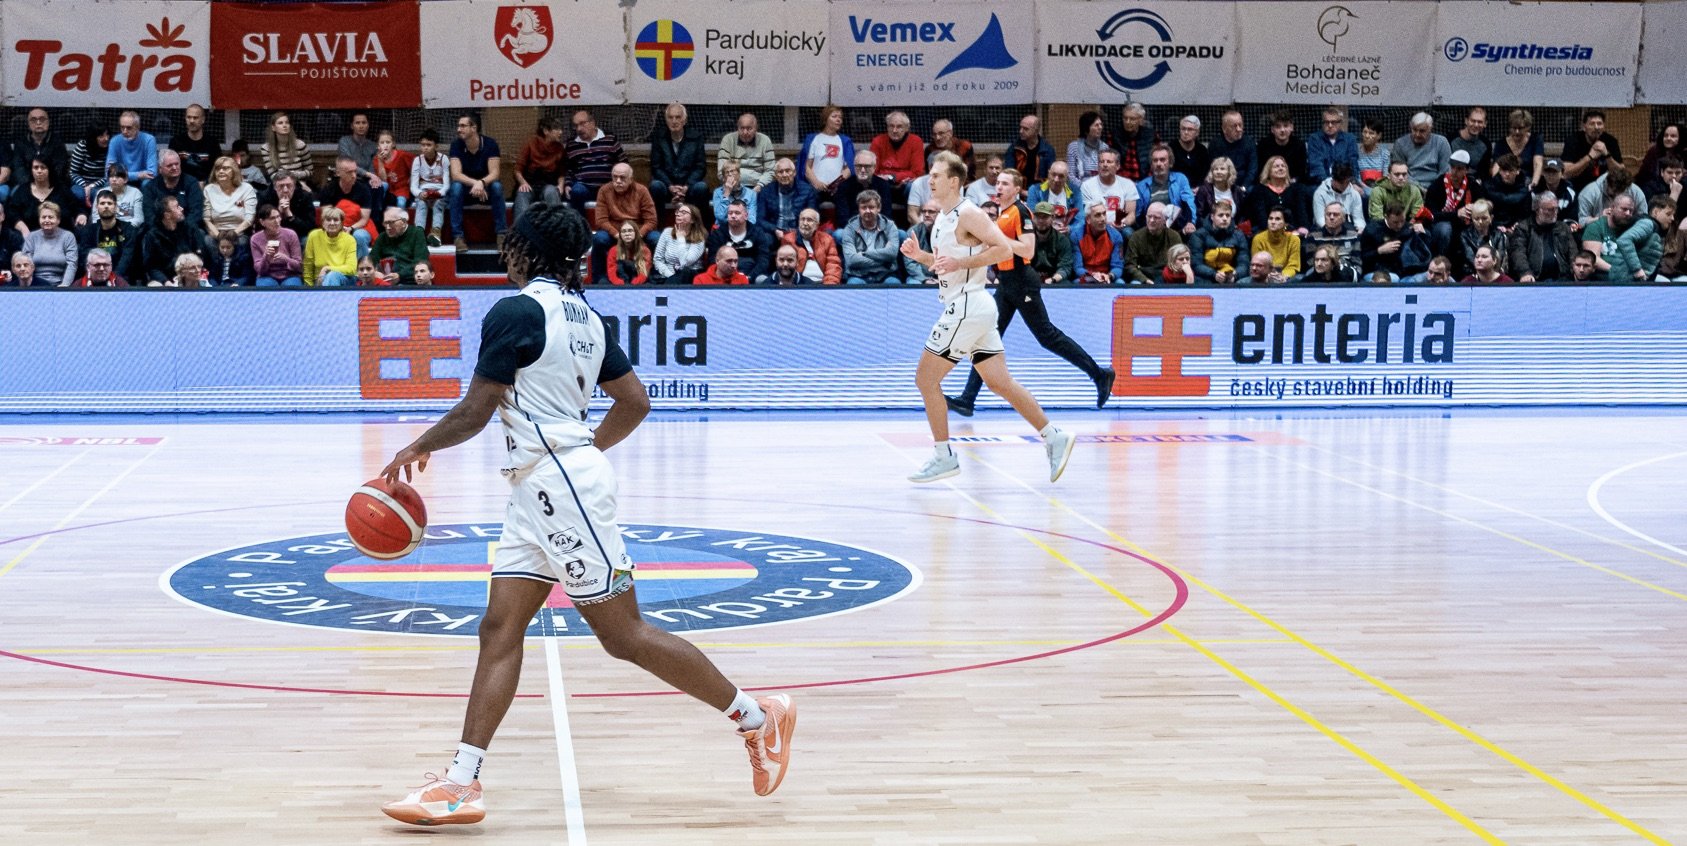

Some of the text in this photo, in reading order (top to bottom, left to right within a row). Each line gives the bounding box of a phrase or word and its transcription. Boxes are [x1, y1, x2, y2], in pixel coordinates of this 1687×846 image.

[848, 15, 956, 43] Vemex
[242, 32, 388, 64] SLAVIA
[705, 28, 826, 55] Pardubický
[1047, 43, 1224, 59] LIKVIDACE ODPADU
[856, 53, 924, 67] ENERGIE
[1471, 43, 1593, 63] Synthesia
[15, 39, 197, 92] Tatra
[300, 66, 389, 80] POJIŠŤOVNA
[705, 55, 745, 79] kraj
[1287, 64, 1381, 80] Bohdaneč
[1504, 63, 1625, 77] Chemie pro budoucnost
[469, 78, 581, 101] Pardubice
[857, 84, 863, 92] s
[933, 81, 948, 91] od
[956, 81, 985, 91] roku
[993, 80, 1019, 91] 2009
[1286, 81, 1379, 98] Medical Spa
[1231, 294, 1456, 365] enteria
[644, 379, 709, 401] olding
[1230, 376, 1454, 400] český stavební holding
[537, 490, 554, 517] 3
